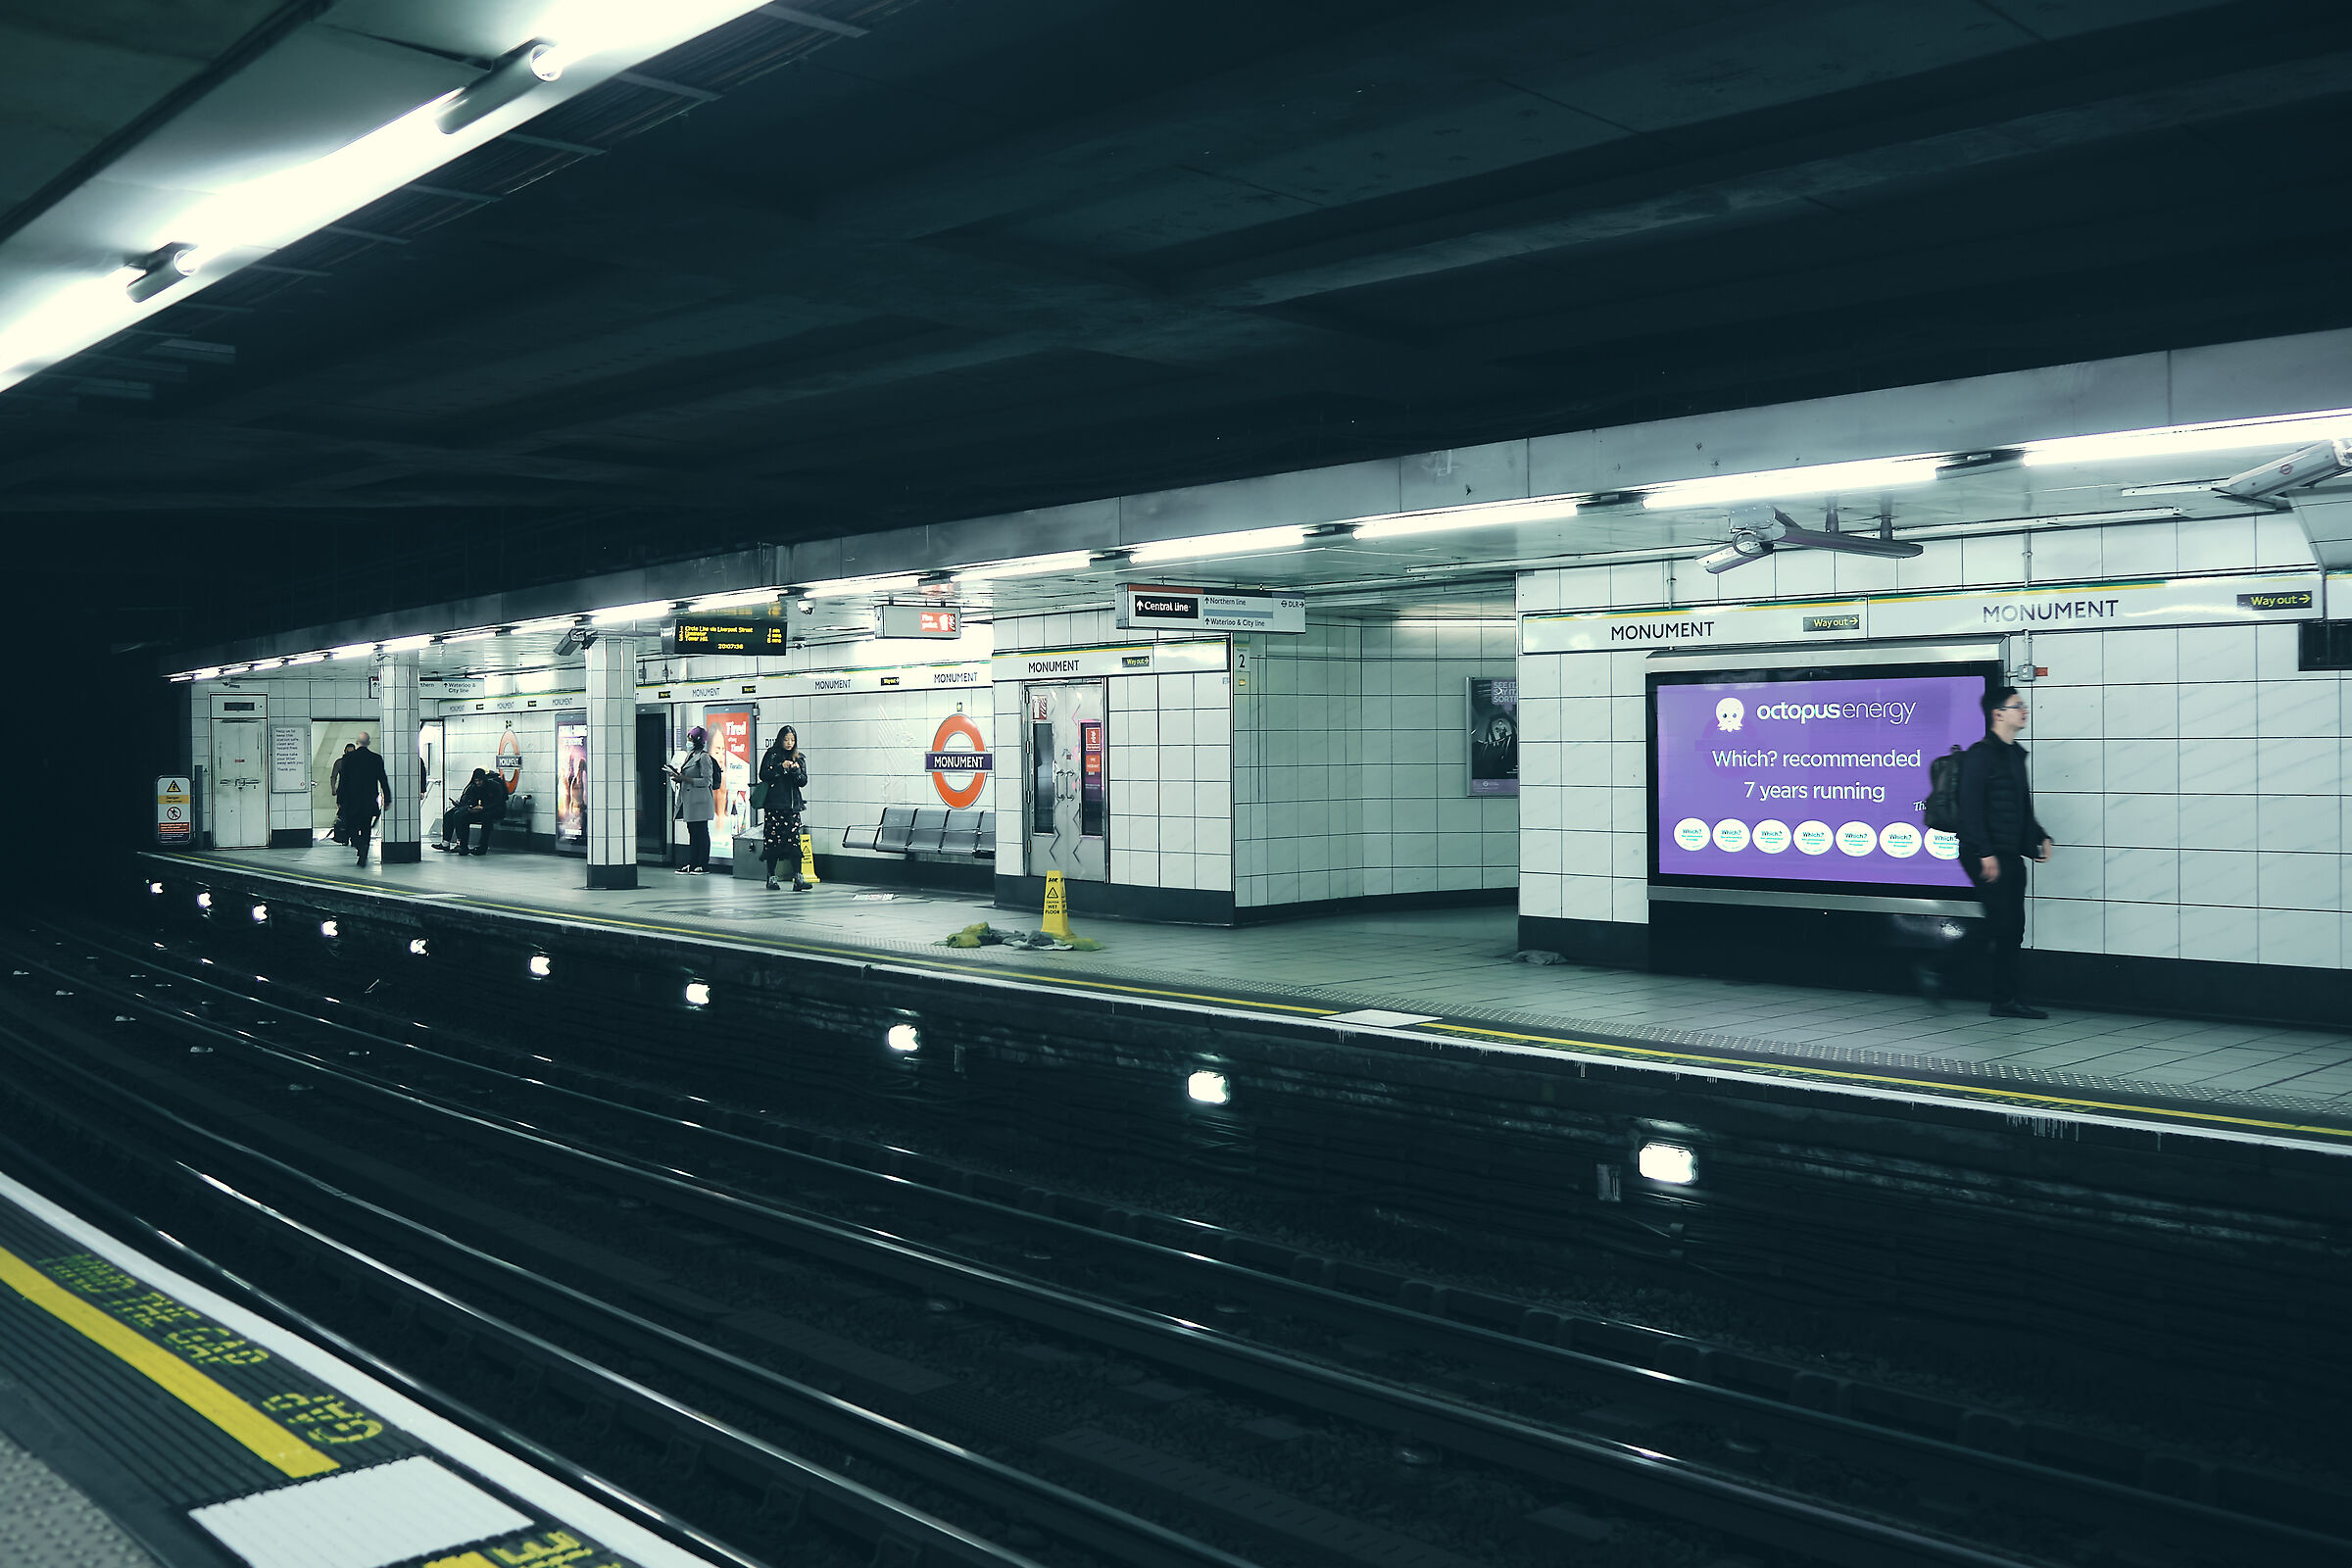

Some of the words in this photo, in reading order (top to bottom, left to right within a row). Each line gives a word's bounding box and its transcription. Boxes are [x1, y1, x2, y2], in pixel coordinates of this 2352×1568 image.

[1145, 601, 1173, 611] Central
[1174, 603, 1189, 612] line
[2251, 596, 2276, 608] Way
[2278, 595, 2297, 605] out
[1984, 600, 2119, 623] MONUMENT
[1814, 618, 1832, 628] Way
[1611, 621, 1714, 640] MONUMENT
[1028, 660, 1079, 673] MONUMENT
[1239, 654, 1246, 667] 2
[814, 679, 852, 689] MONUMENT
[934, 672, 977, 683] MONUMENT
[692, 688, 720, 697] MONUMENT
[1756, 702, 1840, 724] octopus
[1842, 702, 1917, 724] energy
[726, 721, 746, 735] Tired
[934, 756, 984, 768] MONUMENT
[1712, 750, 1778, 767] Which?
[1783, 750, 1921, 767] recommended
[1744, 782, 1755, 798] 7
[1759, 784, 1807, 802] years
[1813, 782, 1885, 803] running
[163, 1326, 270, 1365] GAP
